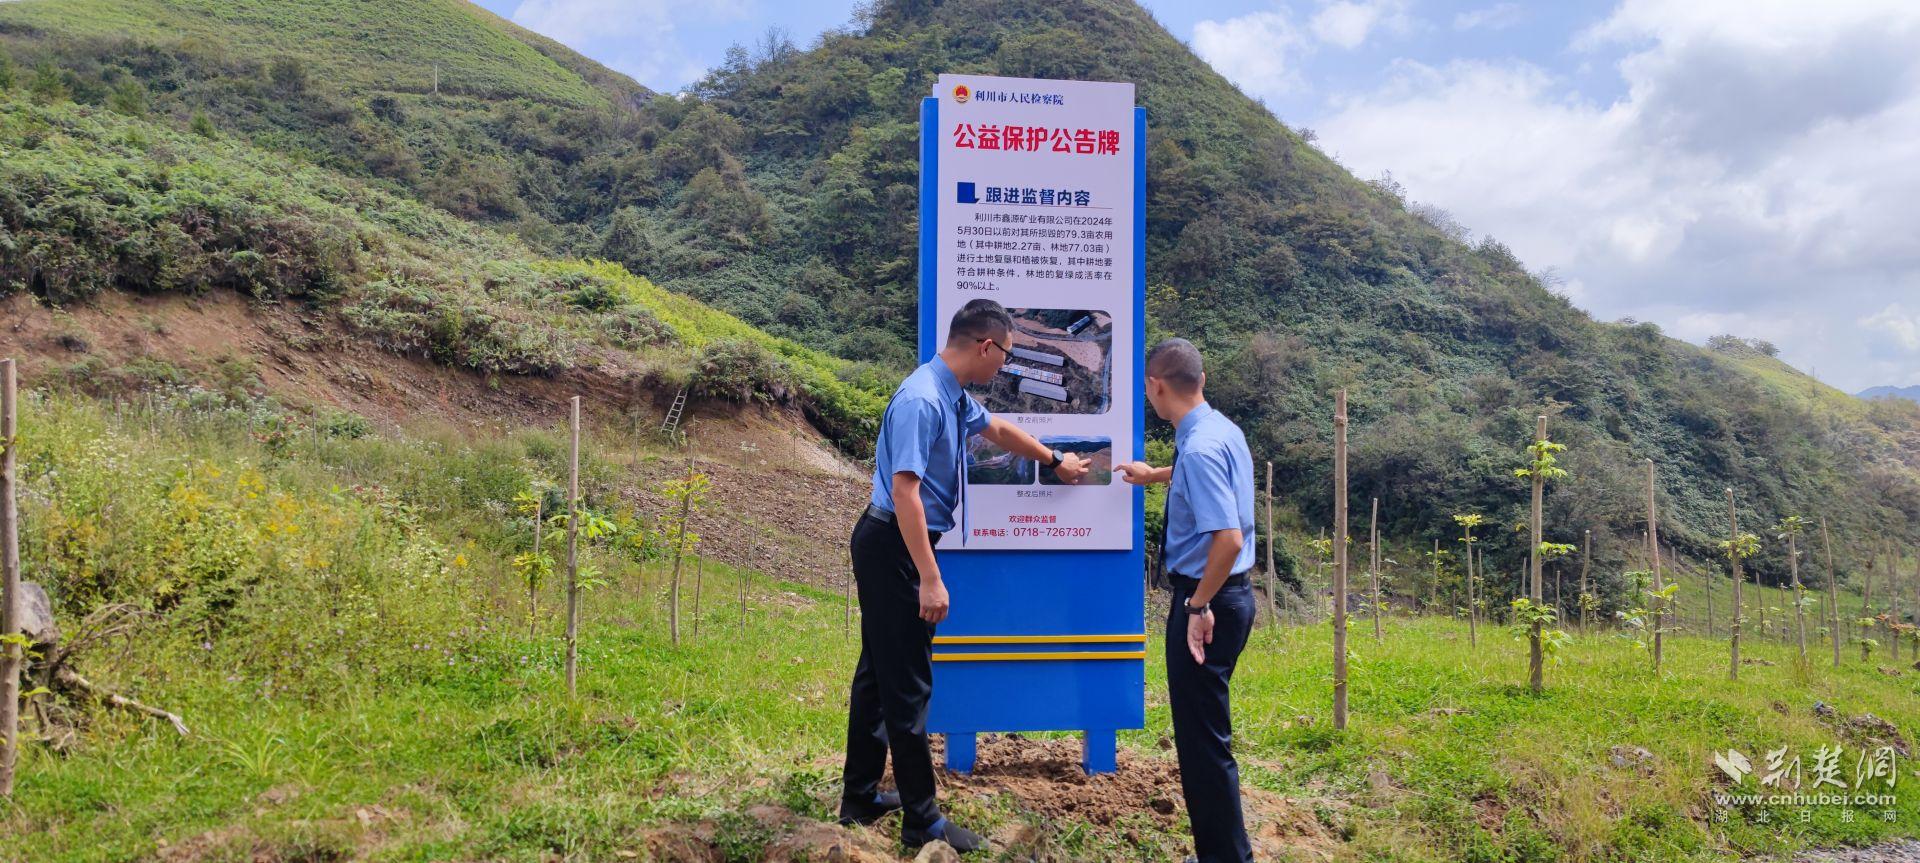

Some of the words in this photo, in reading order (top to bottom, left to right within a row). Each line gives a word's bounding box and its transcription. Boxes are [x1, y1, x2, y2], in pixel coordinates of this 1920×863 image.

[975, 90, 1064, 105] 利川市人民检察院
[953, 123, 1120, 156] 公益保护公告牌
[985, 186, 1091, 206] 跟进监督内容
[975, 212, 1113, 226] 利川市鑫源矿业有限公司在2024年
[957, 226, 1113, 240] 5月30日以前对其所损毁的79.3亩农用
[956, 281, 1001, 291] 90%以上。
[1016, 490, 1053, 498] 整改后照片
[1009, 515, 1057, 524] 欢迎群众监督
